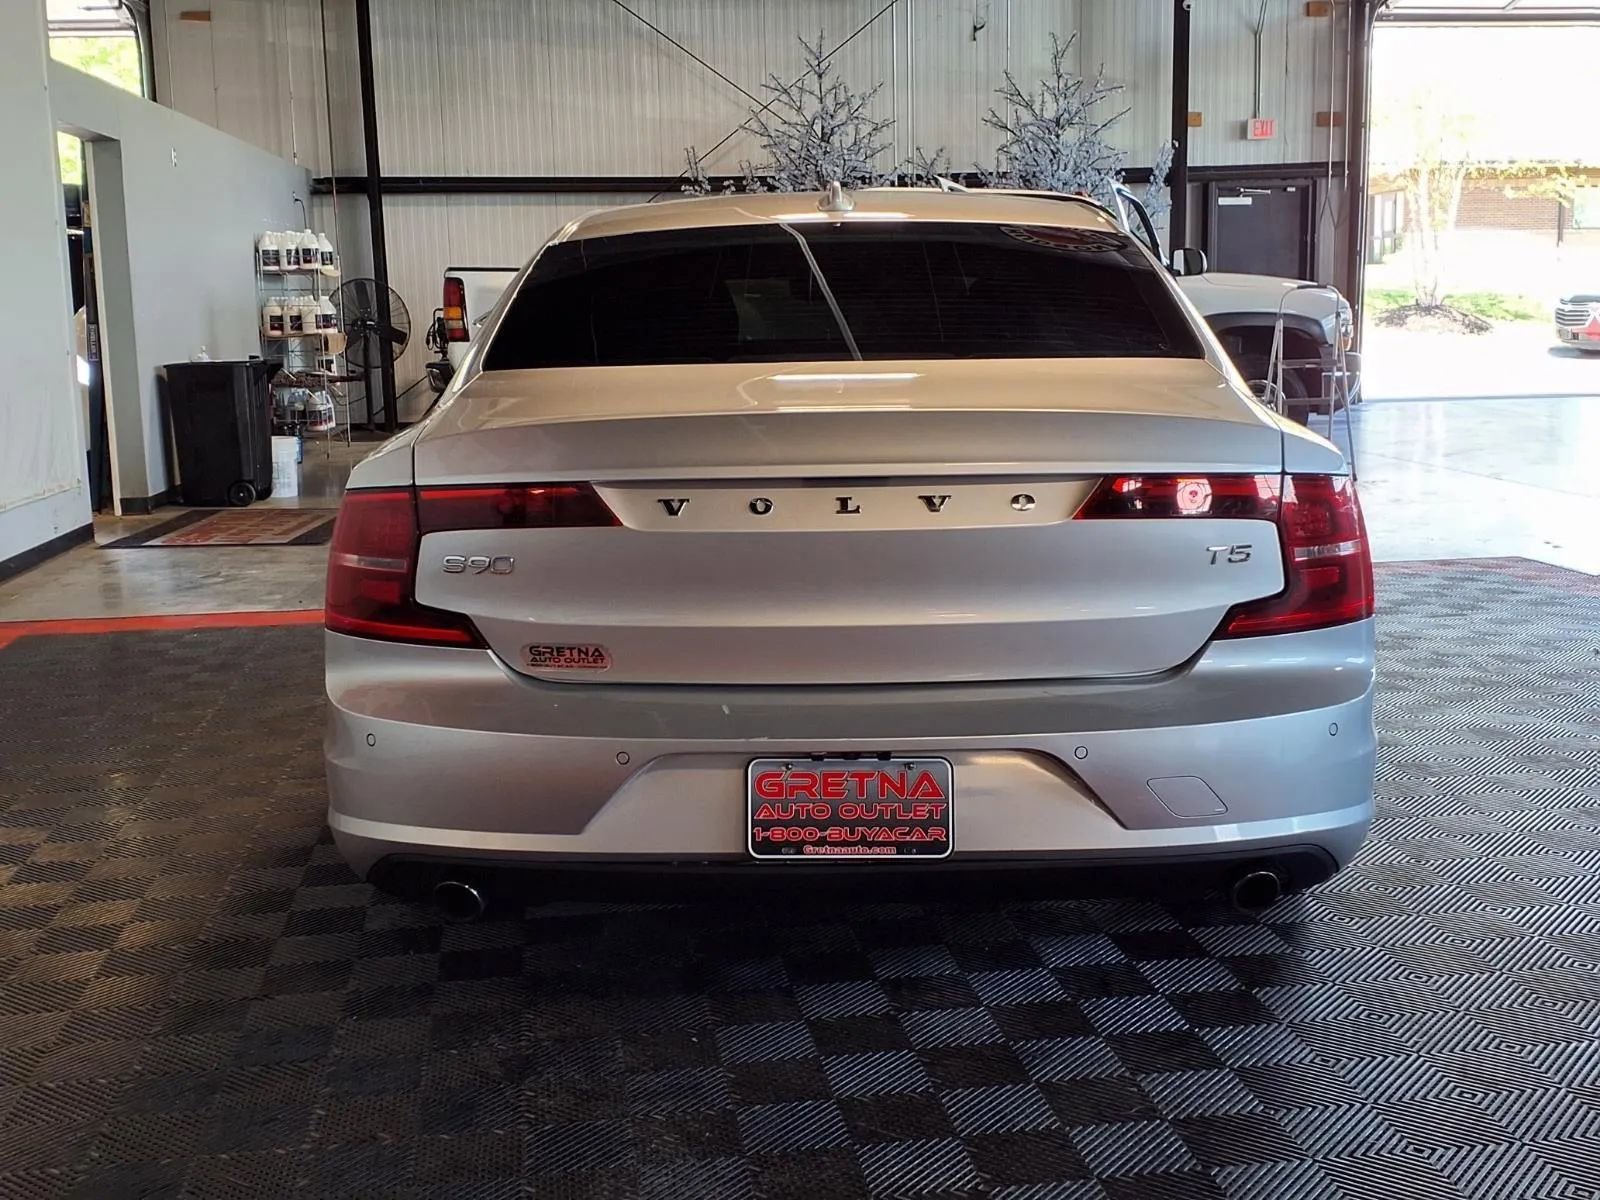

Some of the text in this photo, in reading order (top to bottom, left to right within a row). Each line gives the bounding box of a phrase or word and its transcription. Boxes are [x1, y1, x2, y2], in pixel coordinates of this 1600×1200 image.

[1253, 120, 1273, 137] EXIT
[657, 494, 1036, 517] VOLVO
[1206, 544, 1252, 565] T5
[443, 555, 514, 575] S90
[529, 645, 605, 658] GRETNA
[530, 656, 606, 665] AUTO OUTLET
[754, 770, 945, 800] GRETNA
[754, 803, 947, 820] AUTO OUTLET
[753, 827, 946, 841] 1-800-BUYACAR
[803, 844, 896, 855] Gretnaauto.com
